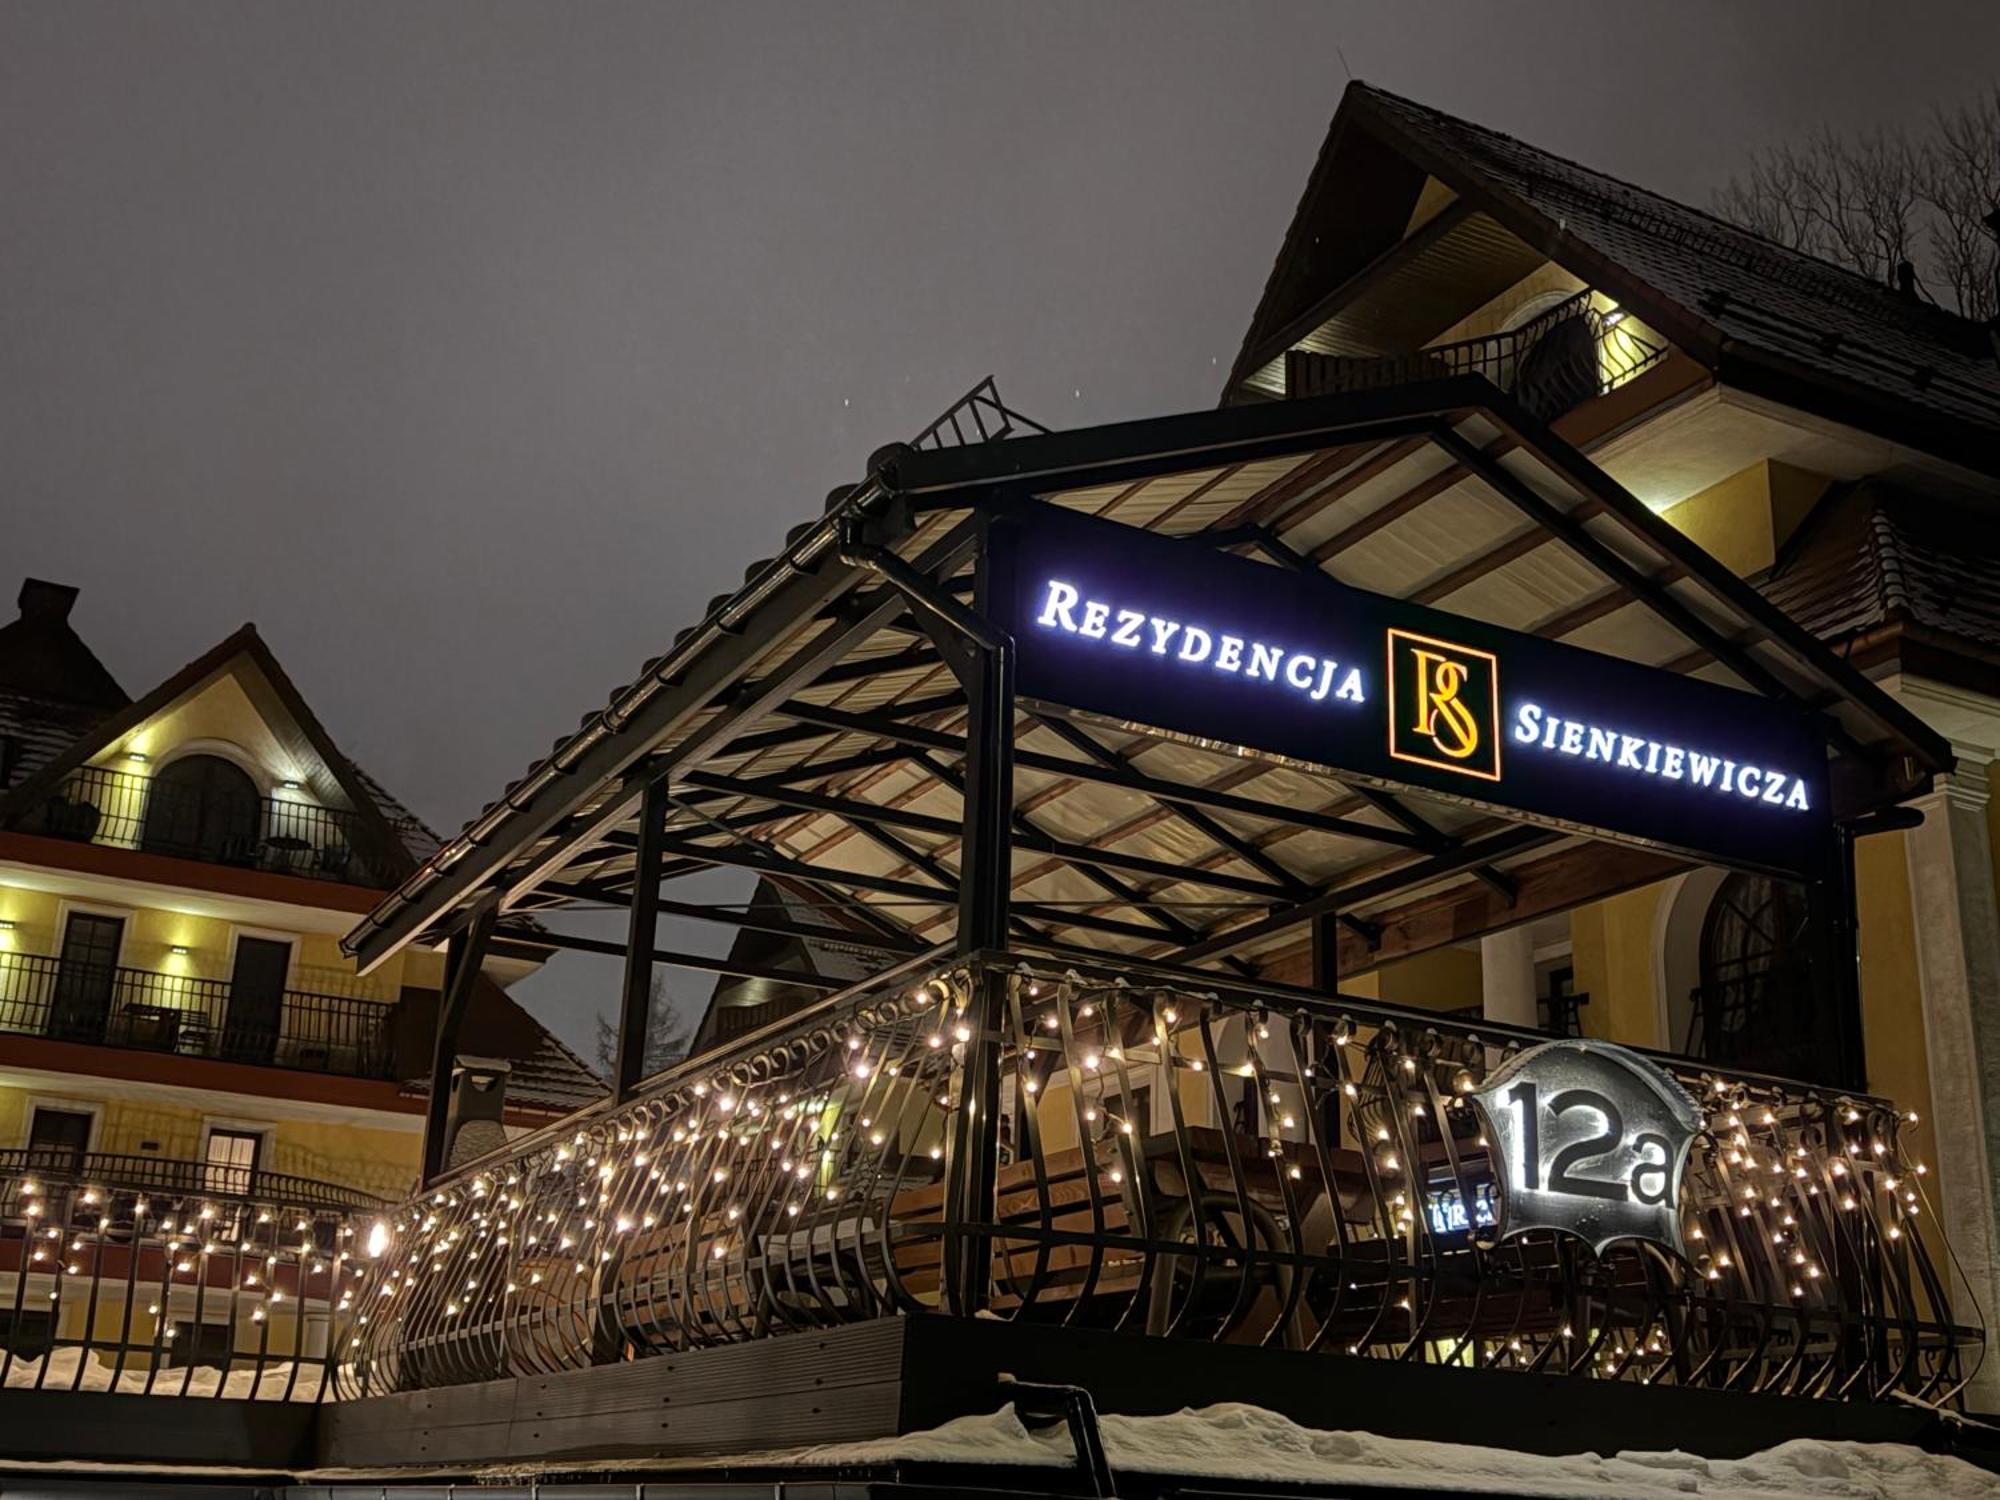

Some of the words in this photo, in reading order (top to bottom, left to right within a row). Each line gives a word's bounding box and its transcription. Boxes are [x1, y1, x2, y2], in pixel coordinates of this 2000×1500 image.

[1038, 580, 1365, 702] REZYDENCJA
[1515, 704, 1809, 810] SIENKIEWICZA
[1508, 1081, 1675, 1210] 12a
